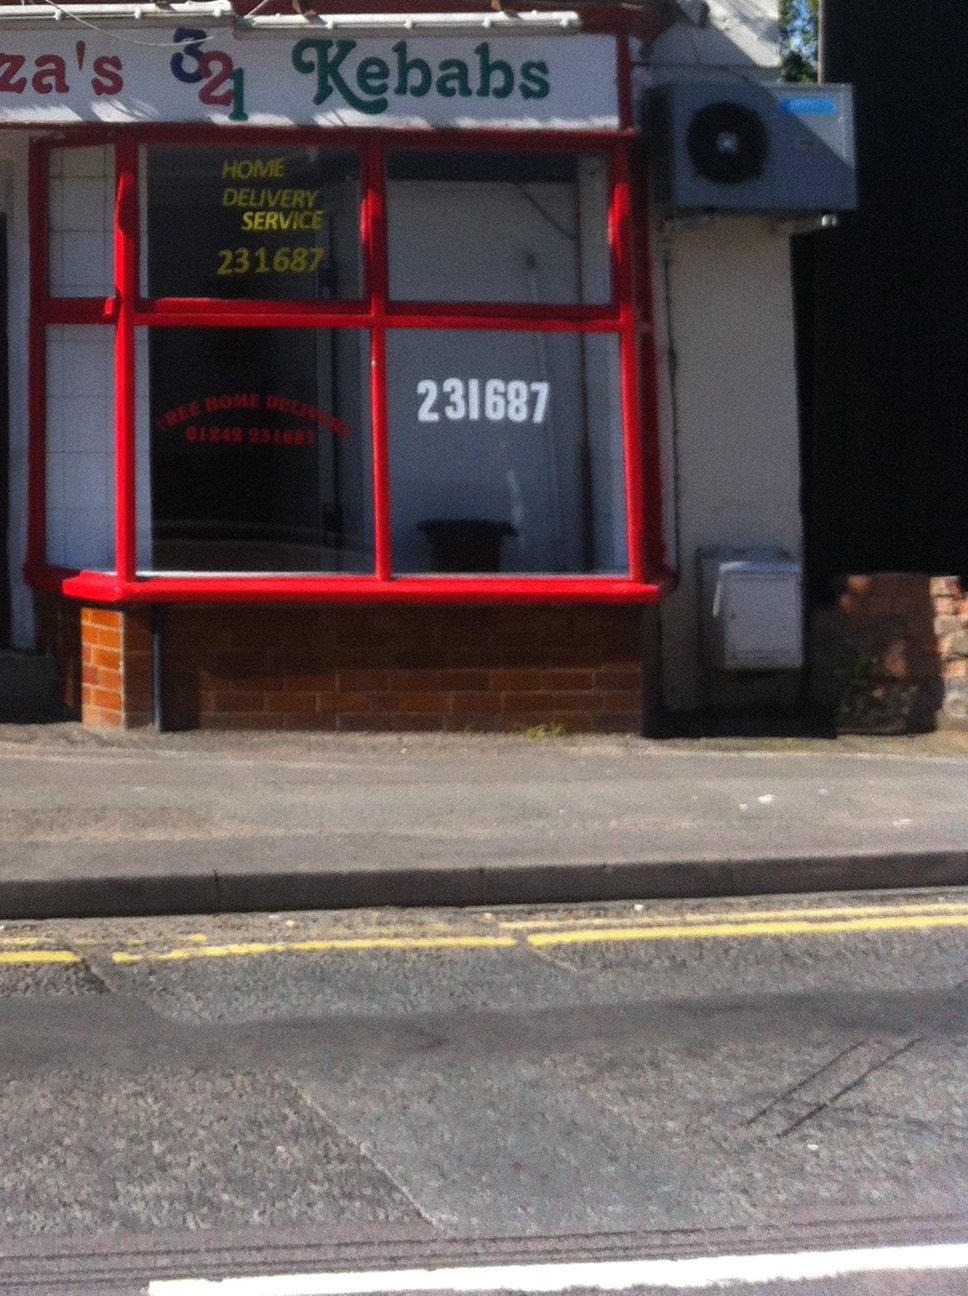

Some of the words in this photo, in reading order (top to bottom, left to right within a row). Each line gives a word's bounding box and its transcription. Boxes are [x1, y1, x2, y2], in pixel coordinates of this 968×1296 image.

[291, 38, 551, 115] Kebabs
[221, 157, 285, 179] HOME
[221, 187, 319, 208] DELIVERY
[240, 210, 324, 232] SERVICE
[216, 247, 325, 277] 231687
[205, 393, 261, 413] HOME
[416, 377, 550, 424] 231687
[247, 426, 316, 445] 231687
